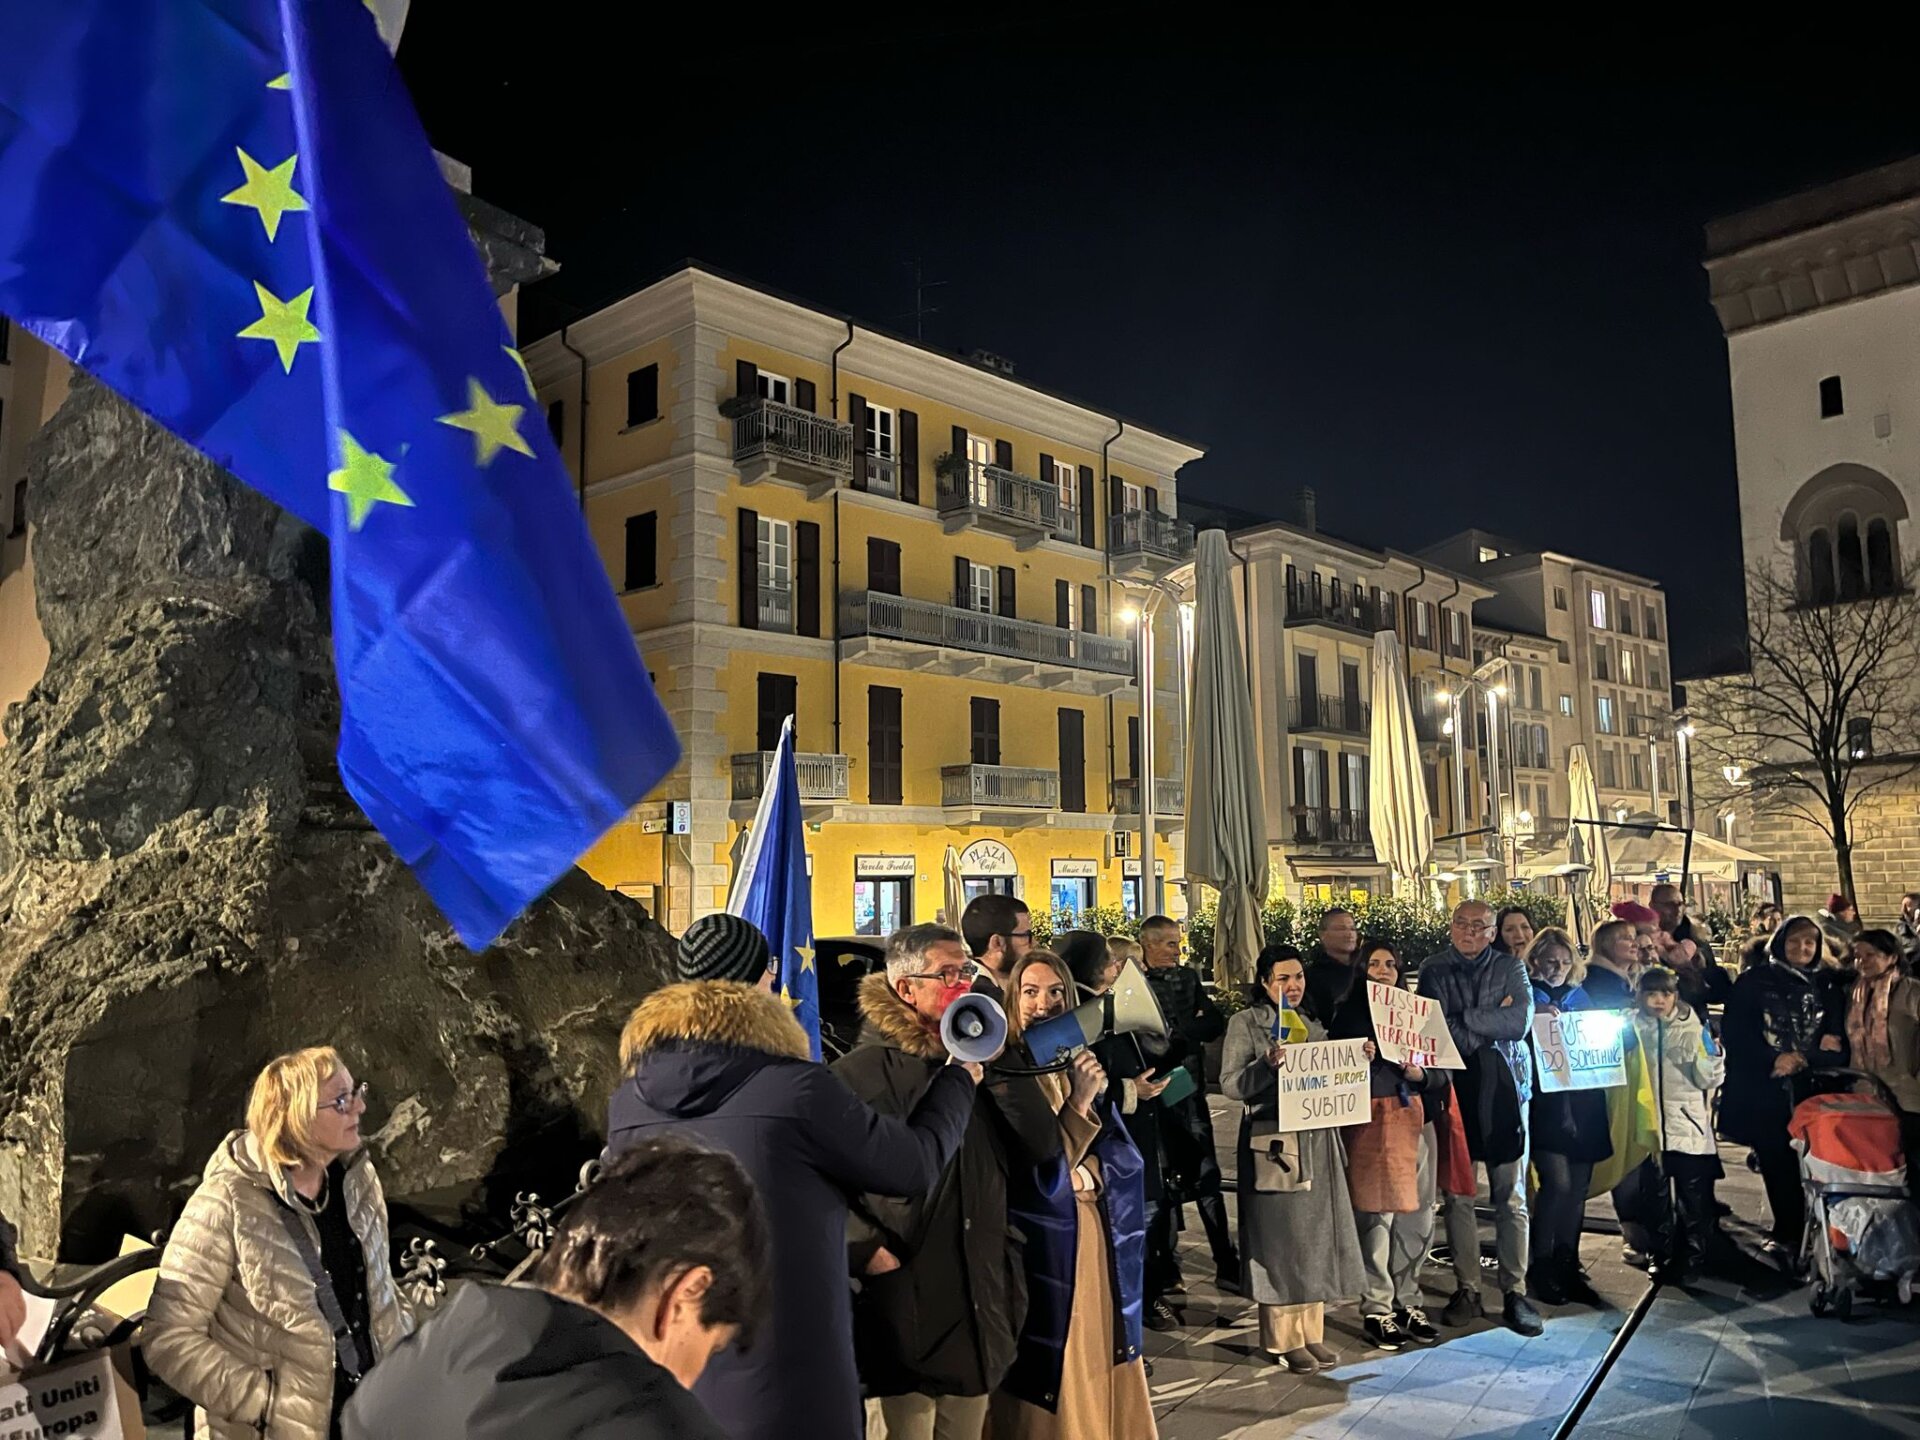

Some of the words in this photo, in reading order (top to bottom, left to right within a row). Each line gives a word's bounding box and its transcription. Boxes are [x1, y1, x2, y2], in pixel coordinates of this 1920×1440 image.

[858, 860, 884, 871] Tavola
[886, 860, 913, 871] Fredda
[969, 845, 1006, 864] PLAZA
[979, 859, 997, 873] Café
[1058, 863, 1080, 874] Music
[1372, 984, 1430, 1016] RUSSIA
[1389, 1007, 1404, 1027] IS
[1376, 1023, 1437, 1053] TERRORIST
[1284, 1044, 1357, 1074] UCRAINA
[1541, 1050, 1565, 1071] DO
[1569, 1047, 1622, 1069] SOMETHING
[1282, 1076, 1294, 1093] IN
[1296, 1074, 1329, 1091] UNIONE
[1334, 1070, 1368, 1086] EUROPEA
[1302, 1092, 1357, 1121] SUBITO
[0, 1395, 34, 1422] ati
[42, 1374, 100, 1409] Uniti
